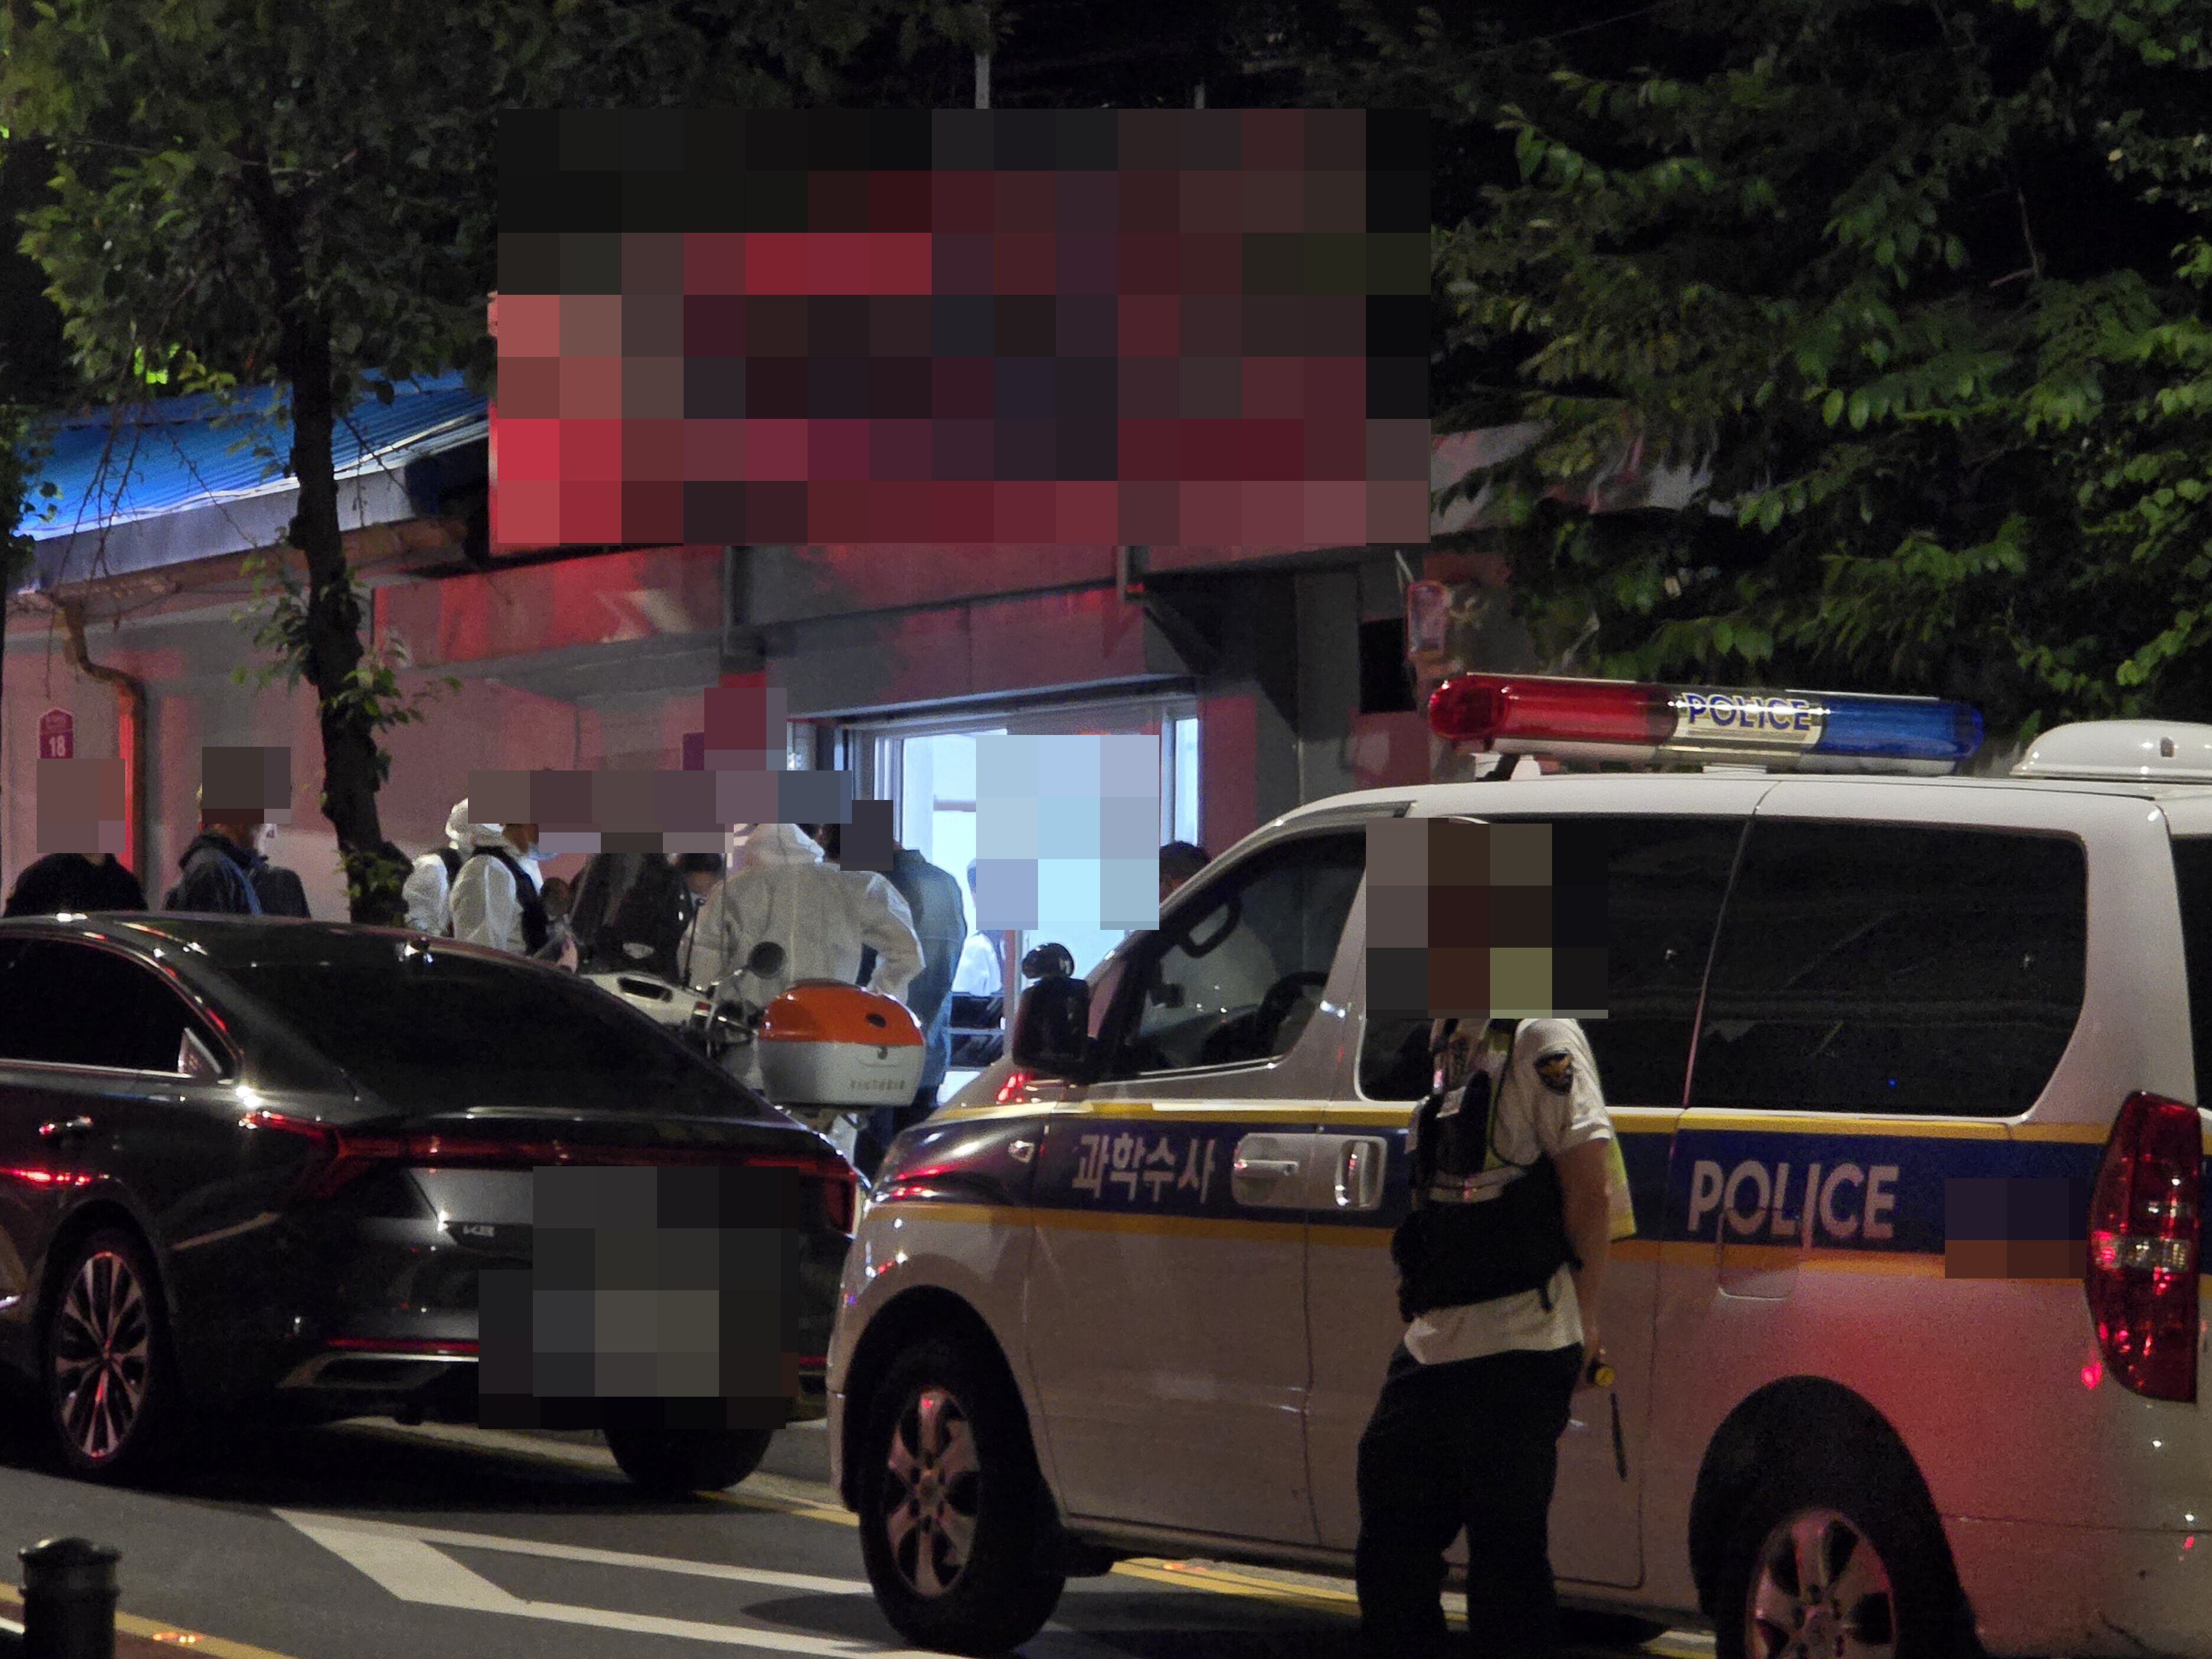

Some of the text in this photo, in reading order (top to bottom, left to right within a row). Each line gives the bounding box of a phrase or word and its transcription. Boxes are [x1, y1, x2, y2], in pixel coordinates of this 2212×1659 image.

[1683, 692, 1810, 731] POLICE
[1072, 1132, 1215, 1203] 과학수사
[1687, 1160, 1900, 1240] POLICE
